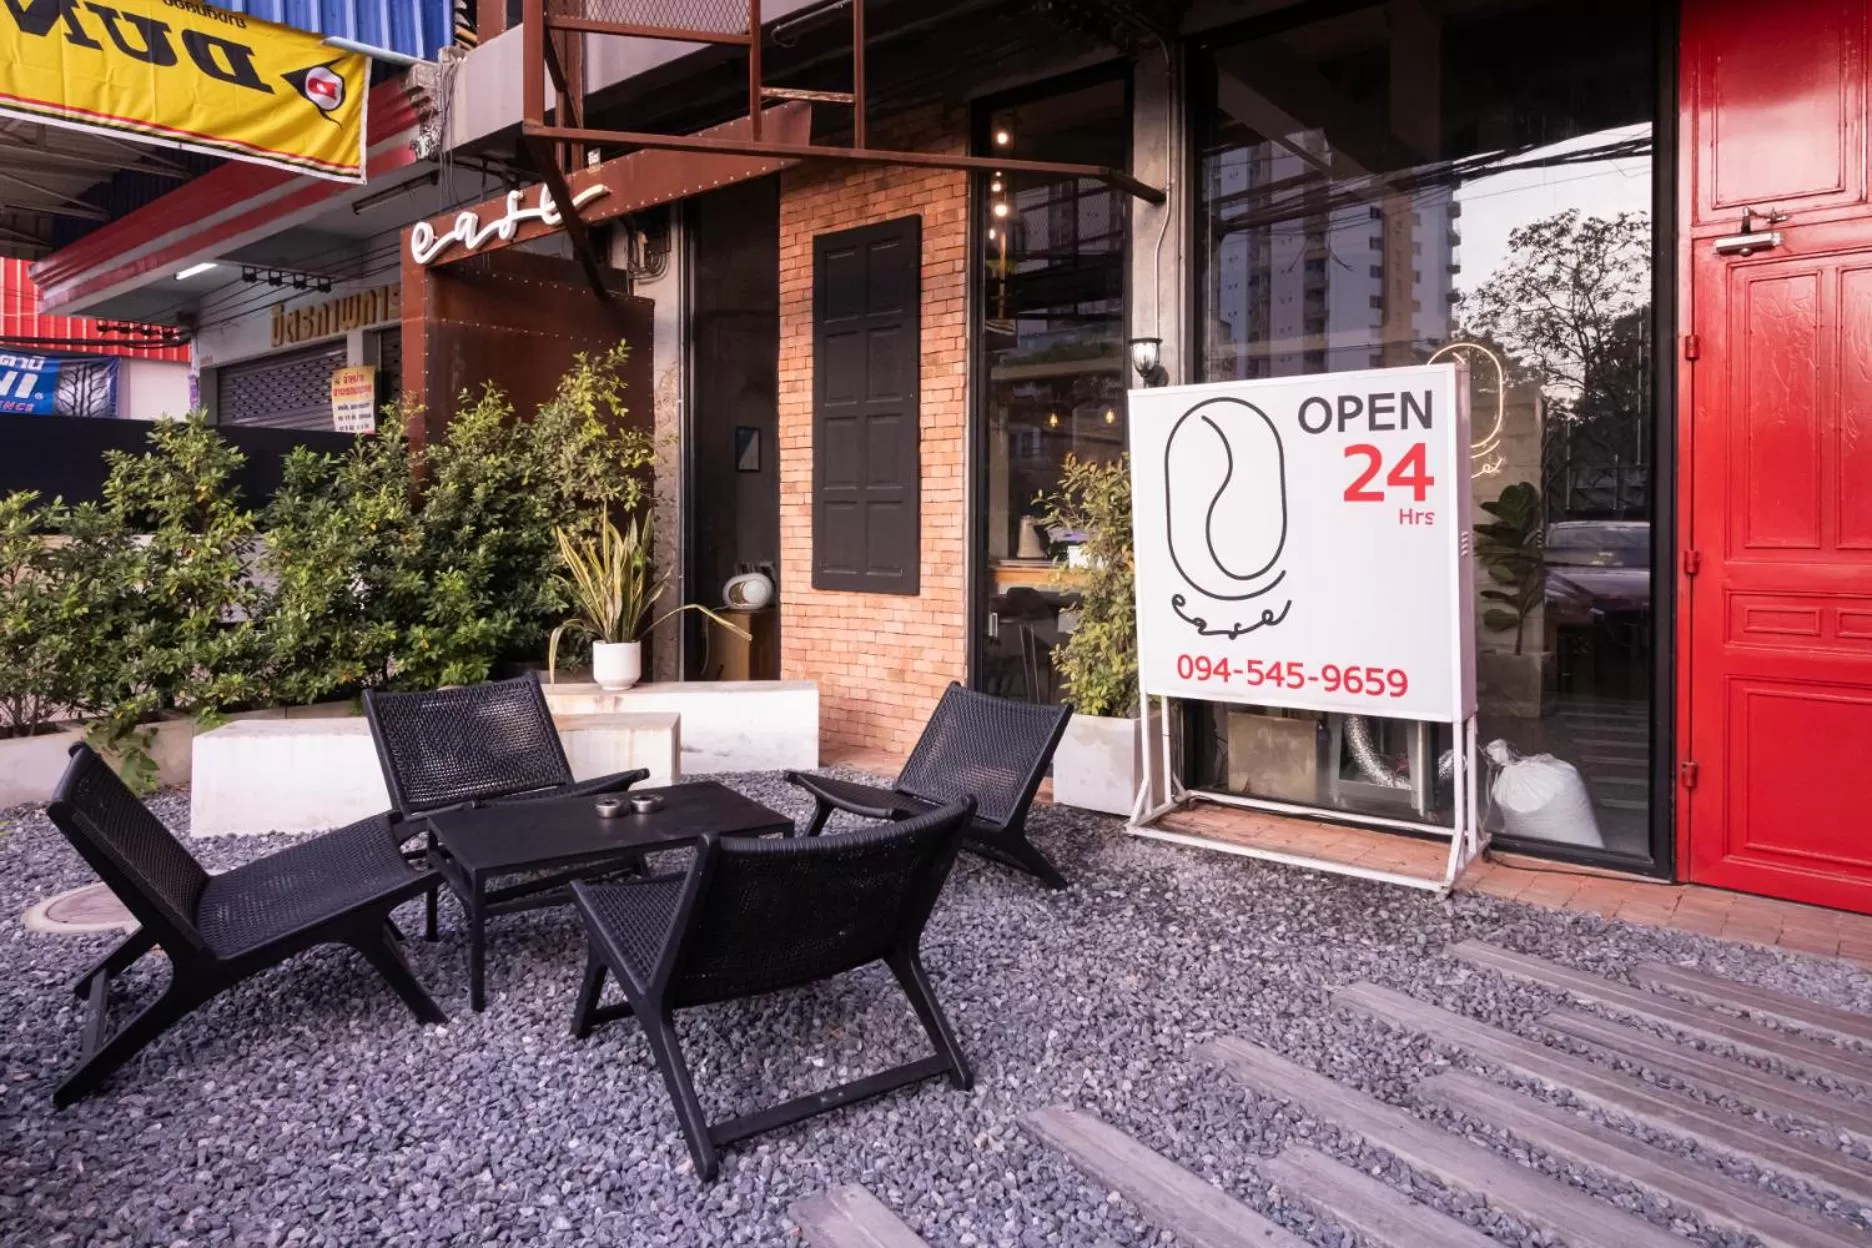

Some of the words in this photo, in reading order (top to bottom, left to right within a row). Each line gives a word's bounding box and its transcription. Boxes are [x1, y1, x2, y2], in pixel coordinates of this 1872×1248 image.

[1298, 390, 1433, 435] OPEN
[1343, 442, 1435, 502] 24
[1398, 508, 1435, 526] Hrs
[1176, 653, 1409, 698] 094-545-9659
